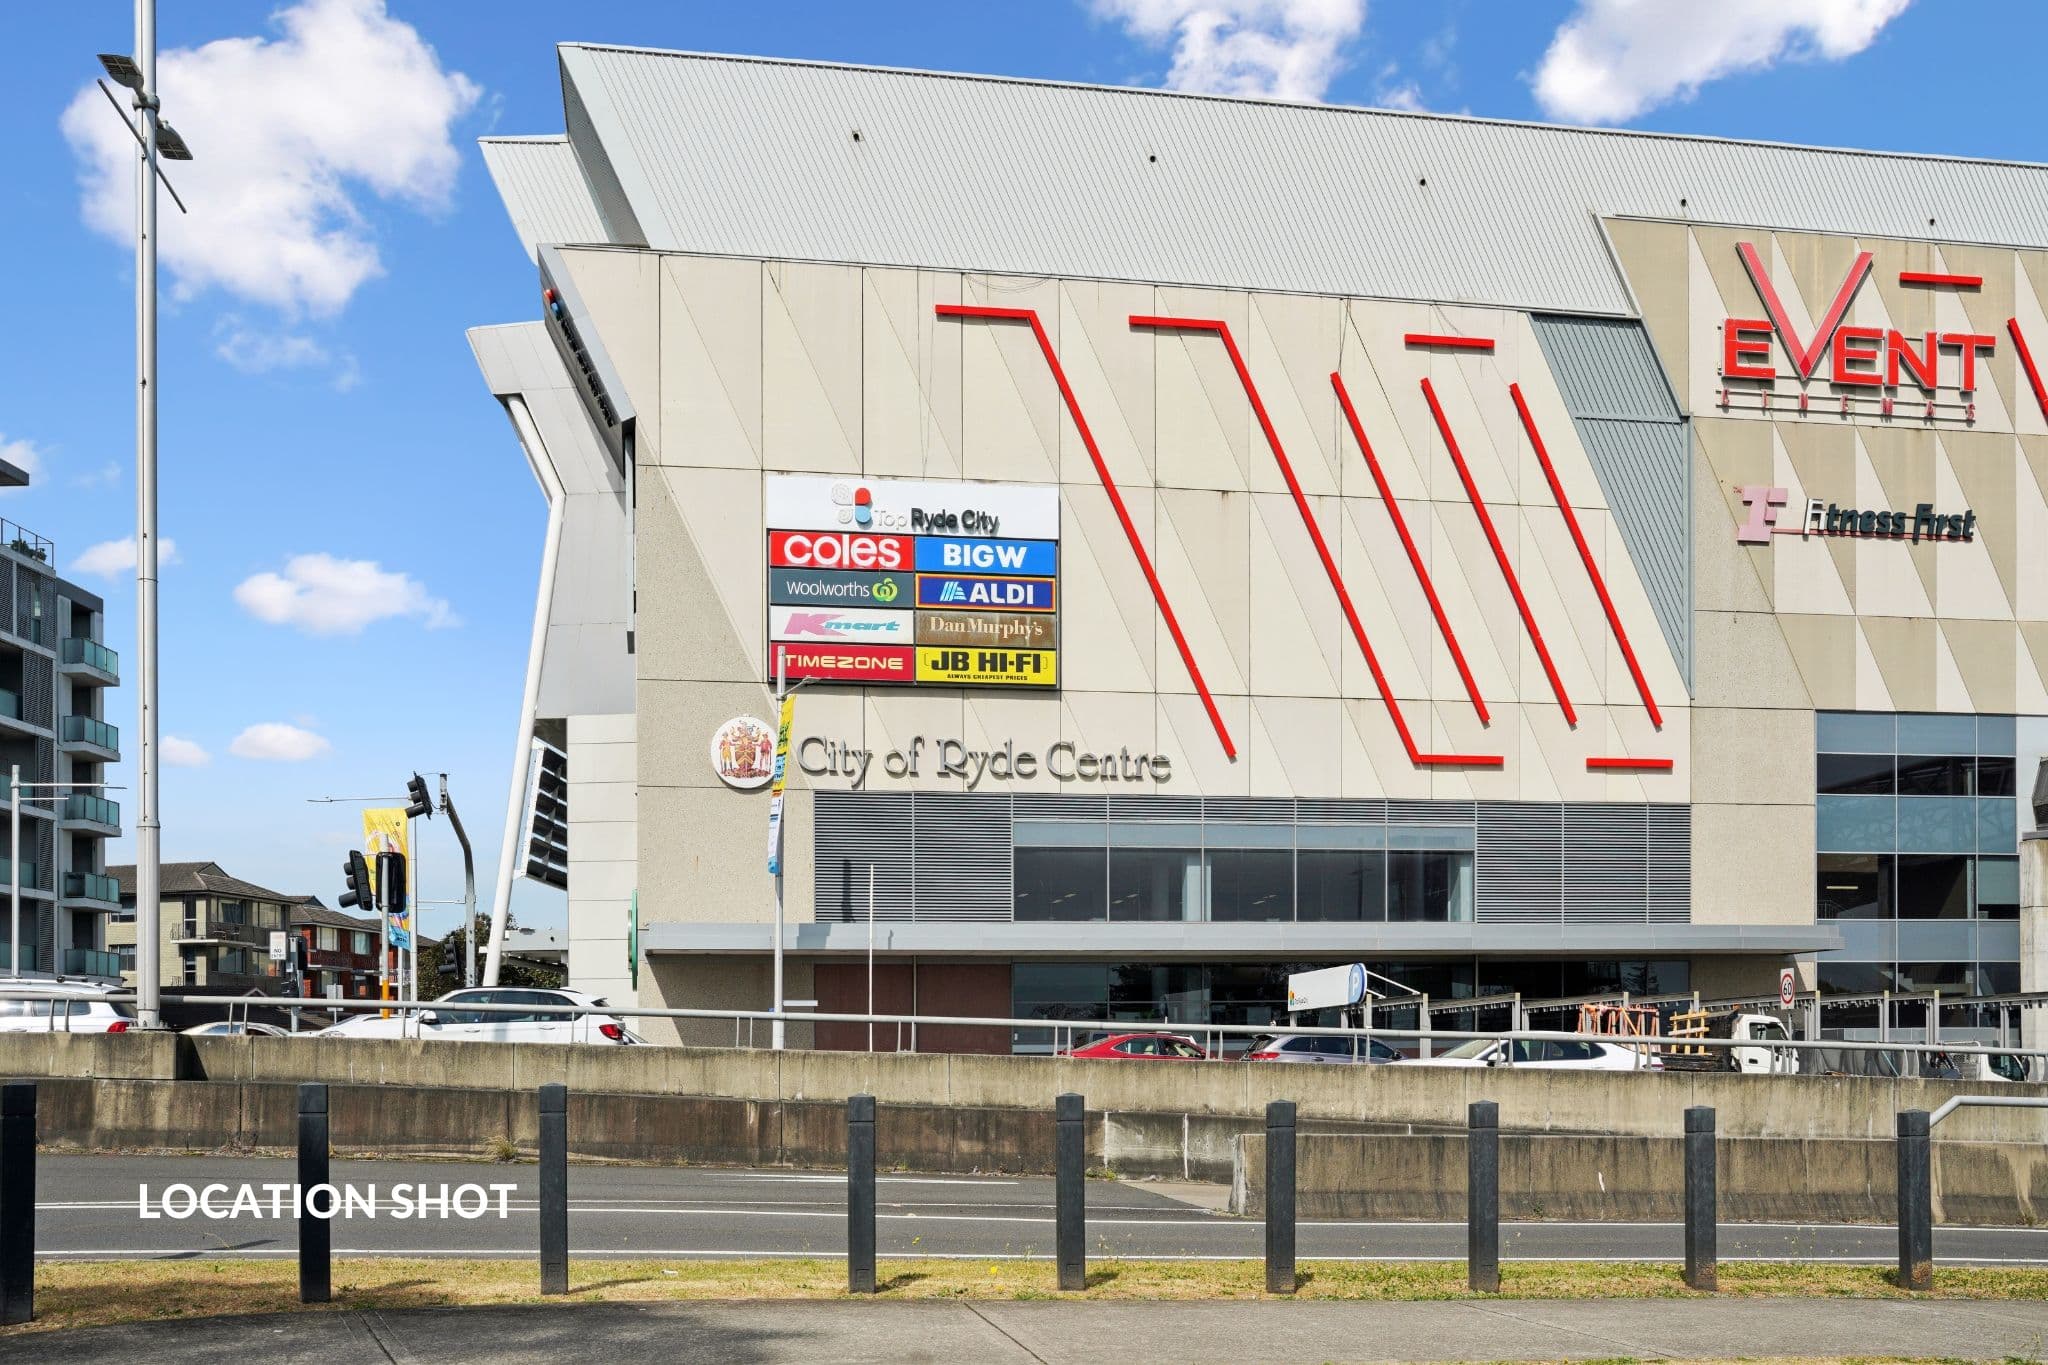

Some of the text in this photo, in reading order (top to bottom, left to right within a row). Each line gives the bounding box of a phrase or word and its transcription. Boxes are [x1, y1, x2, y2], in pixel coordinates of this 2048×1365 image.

[1722, 242, 1996, 392] EVENT
[1721, 388, 1976, 421] CINEMAS
[875, 508, 998, 534] Top Ryde City
[1803, 499, 1976, 544] Fitness First
[784, 534, 900, 567] coles
[786, 580, 870, 597] Woolworths
[969, 583, 1034, 605] ALDI
[784, 613, 900, 636] Kmart
[930, 616, 1043, 640] Dan Murphy's
[785, 654, 903, 670] TIMEZONE
[931, 651, 1040, 673] JB HI-FI
[796, 735, 874, 789] City
[883, 735, 925, 779] of
[936, 738, 1038, 790] Ryde
[1045, 740, 1172, 780] Centre
[1783, 982, 1792, 995] 60
